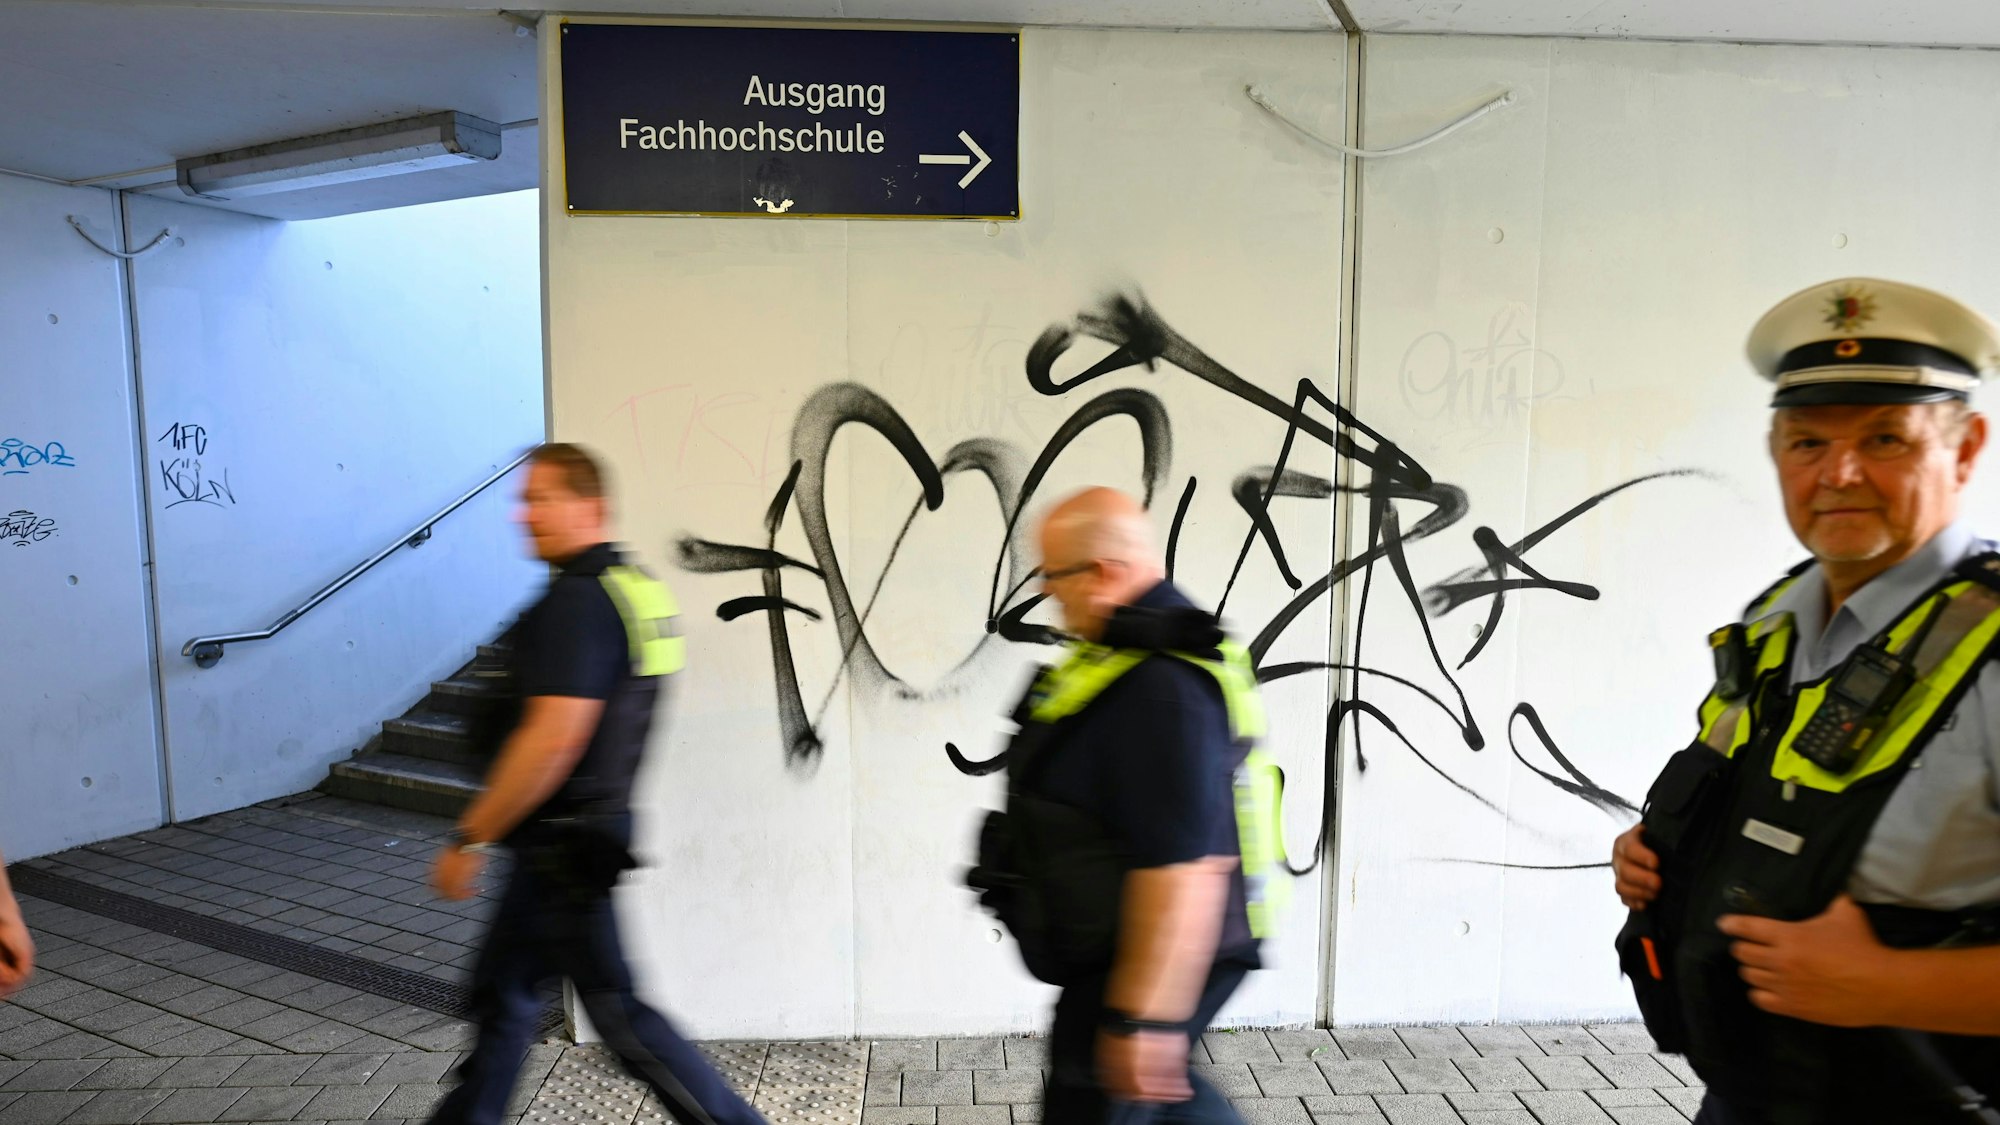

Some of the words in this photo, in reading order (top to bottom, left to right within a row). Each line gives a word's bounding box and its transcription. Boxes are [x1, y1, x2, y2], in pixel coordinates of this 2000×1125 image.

[743, 75, 886, 116] Ausgang
[620, 118, 886, 154] Fachhochschule
[160, 458, 236, 504] KÖLN
